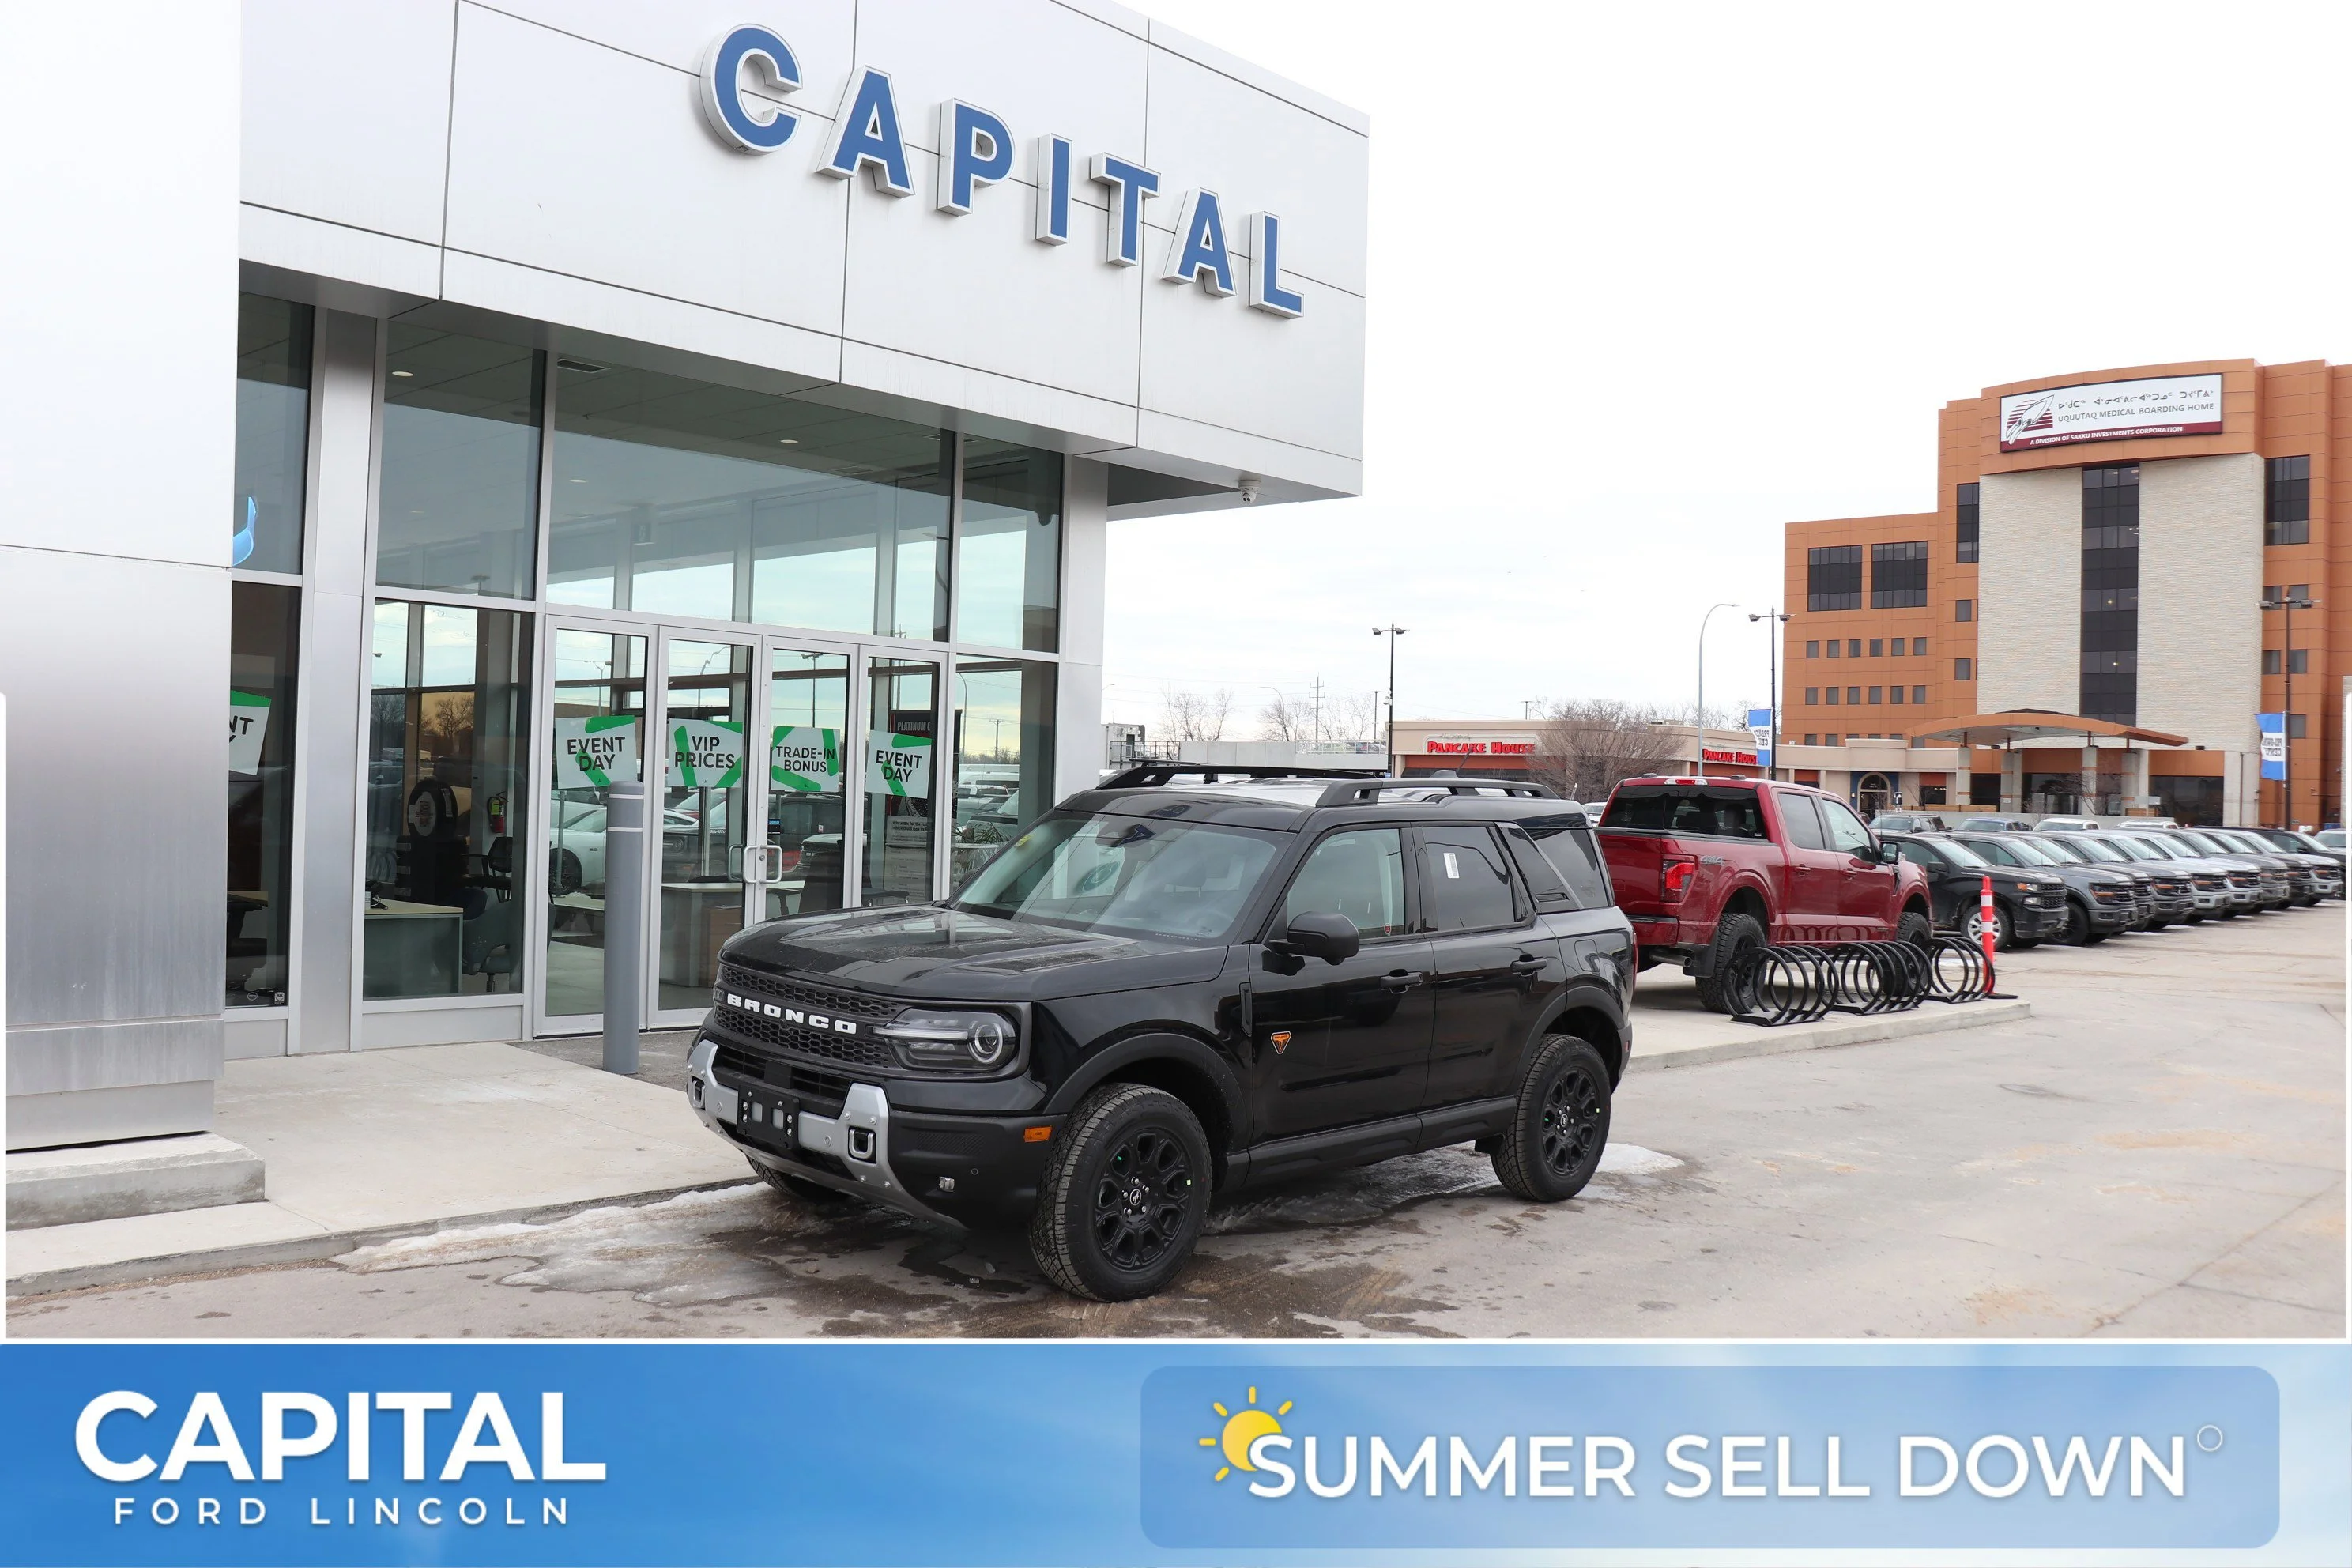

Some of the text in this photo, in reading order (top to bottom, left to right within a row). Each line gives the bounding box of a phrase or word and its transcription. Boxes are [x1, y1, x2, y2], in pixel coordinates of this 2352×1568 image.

[702, 23, 1304, 318] CAPITAL
[2058, 412, 2098, 422] UQUUTAQ
[2139, 405, 2185, 414] BOARDING
[2035, 436, 2060, 445] DIVISION
[2091, 429, 2135, 438] INVESTMENTS
[897, 721, 927, 731] PLATINUM
[567, 736, 625, 755] EVENT
[692, 735, 720, 752] VIP
[1427, 741, 1536, 754] PANCAKE HOUSE
[674, 752, 735, 769] PRICES
[776, 745, 835, 760] TRADE-IN
[876, 749, 923, 769] EVENT
[1702, 748, 1758, 766] PANCAKE HOUS
[579, 754, 615, 771] DAY
[784, 760, 827, 773] BONUS
[883, 766, 913, 782] DAY
[727, 993, 857, 1035] BRONCO
